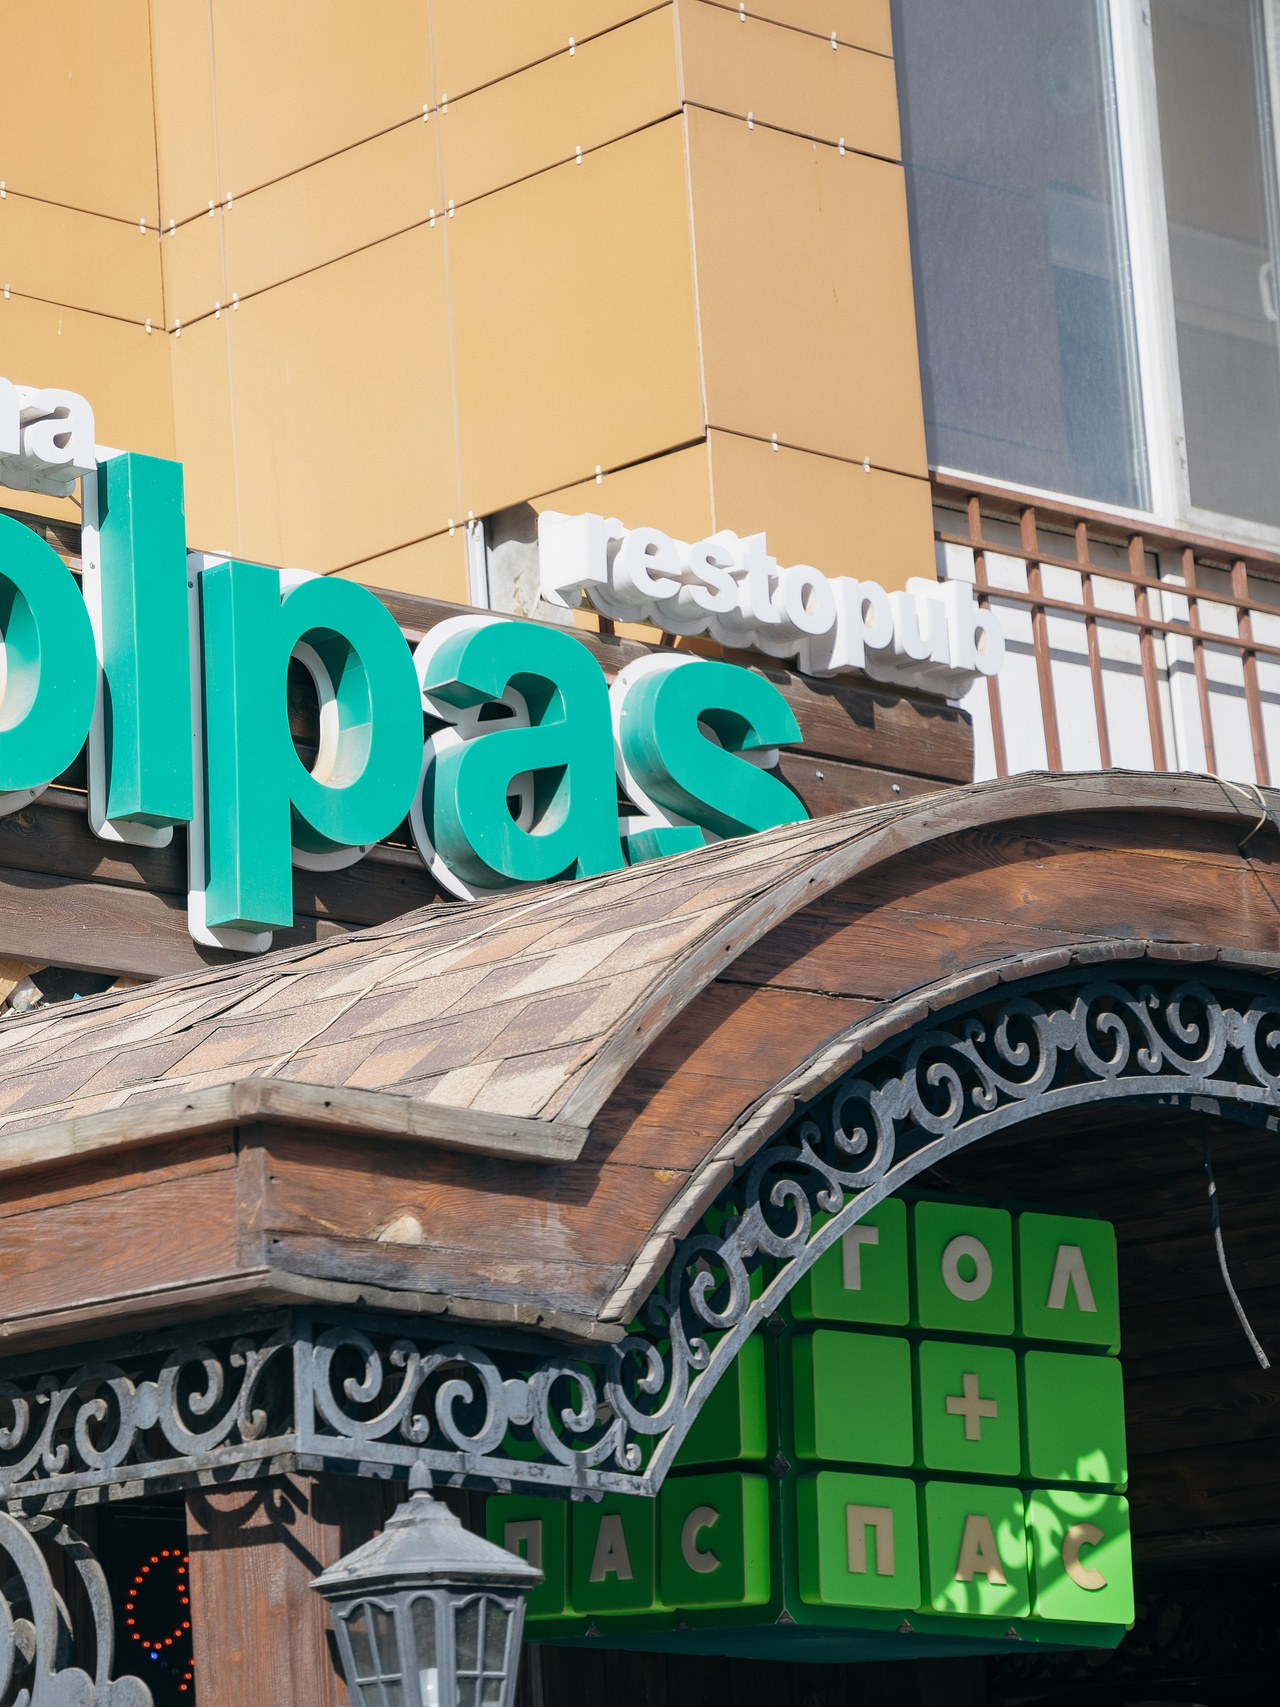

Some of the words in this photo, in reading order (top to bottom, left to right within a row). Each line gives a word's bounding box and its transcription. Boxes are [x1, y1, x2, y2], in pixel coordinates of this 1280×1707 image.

[538, 510, 1006, 698] restopub
[841, 1223, 1098, 1314] ГОЛ
[504, 1506, 721, 1583] ПАС
[845, 1503, 1109, 1591] ПАС
